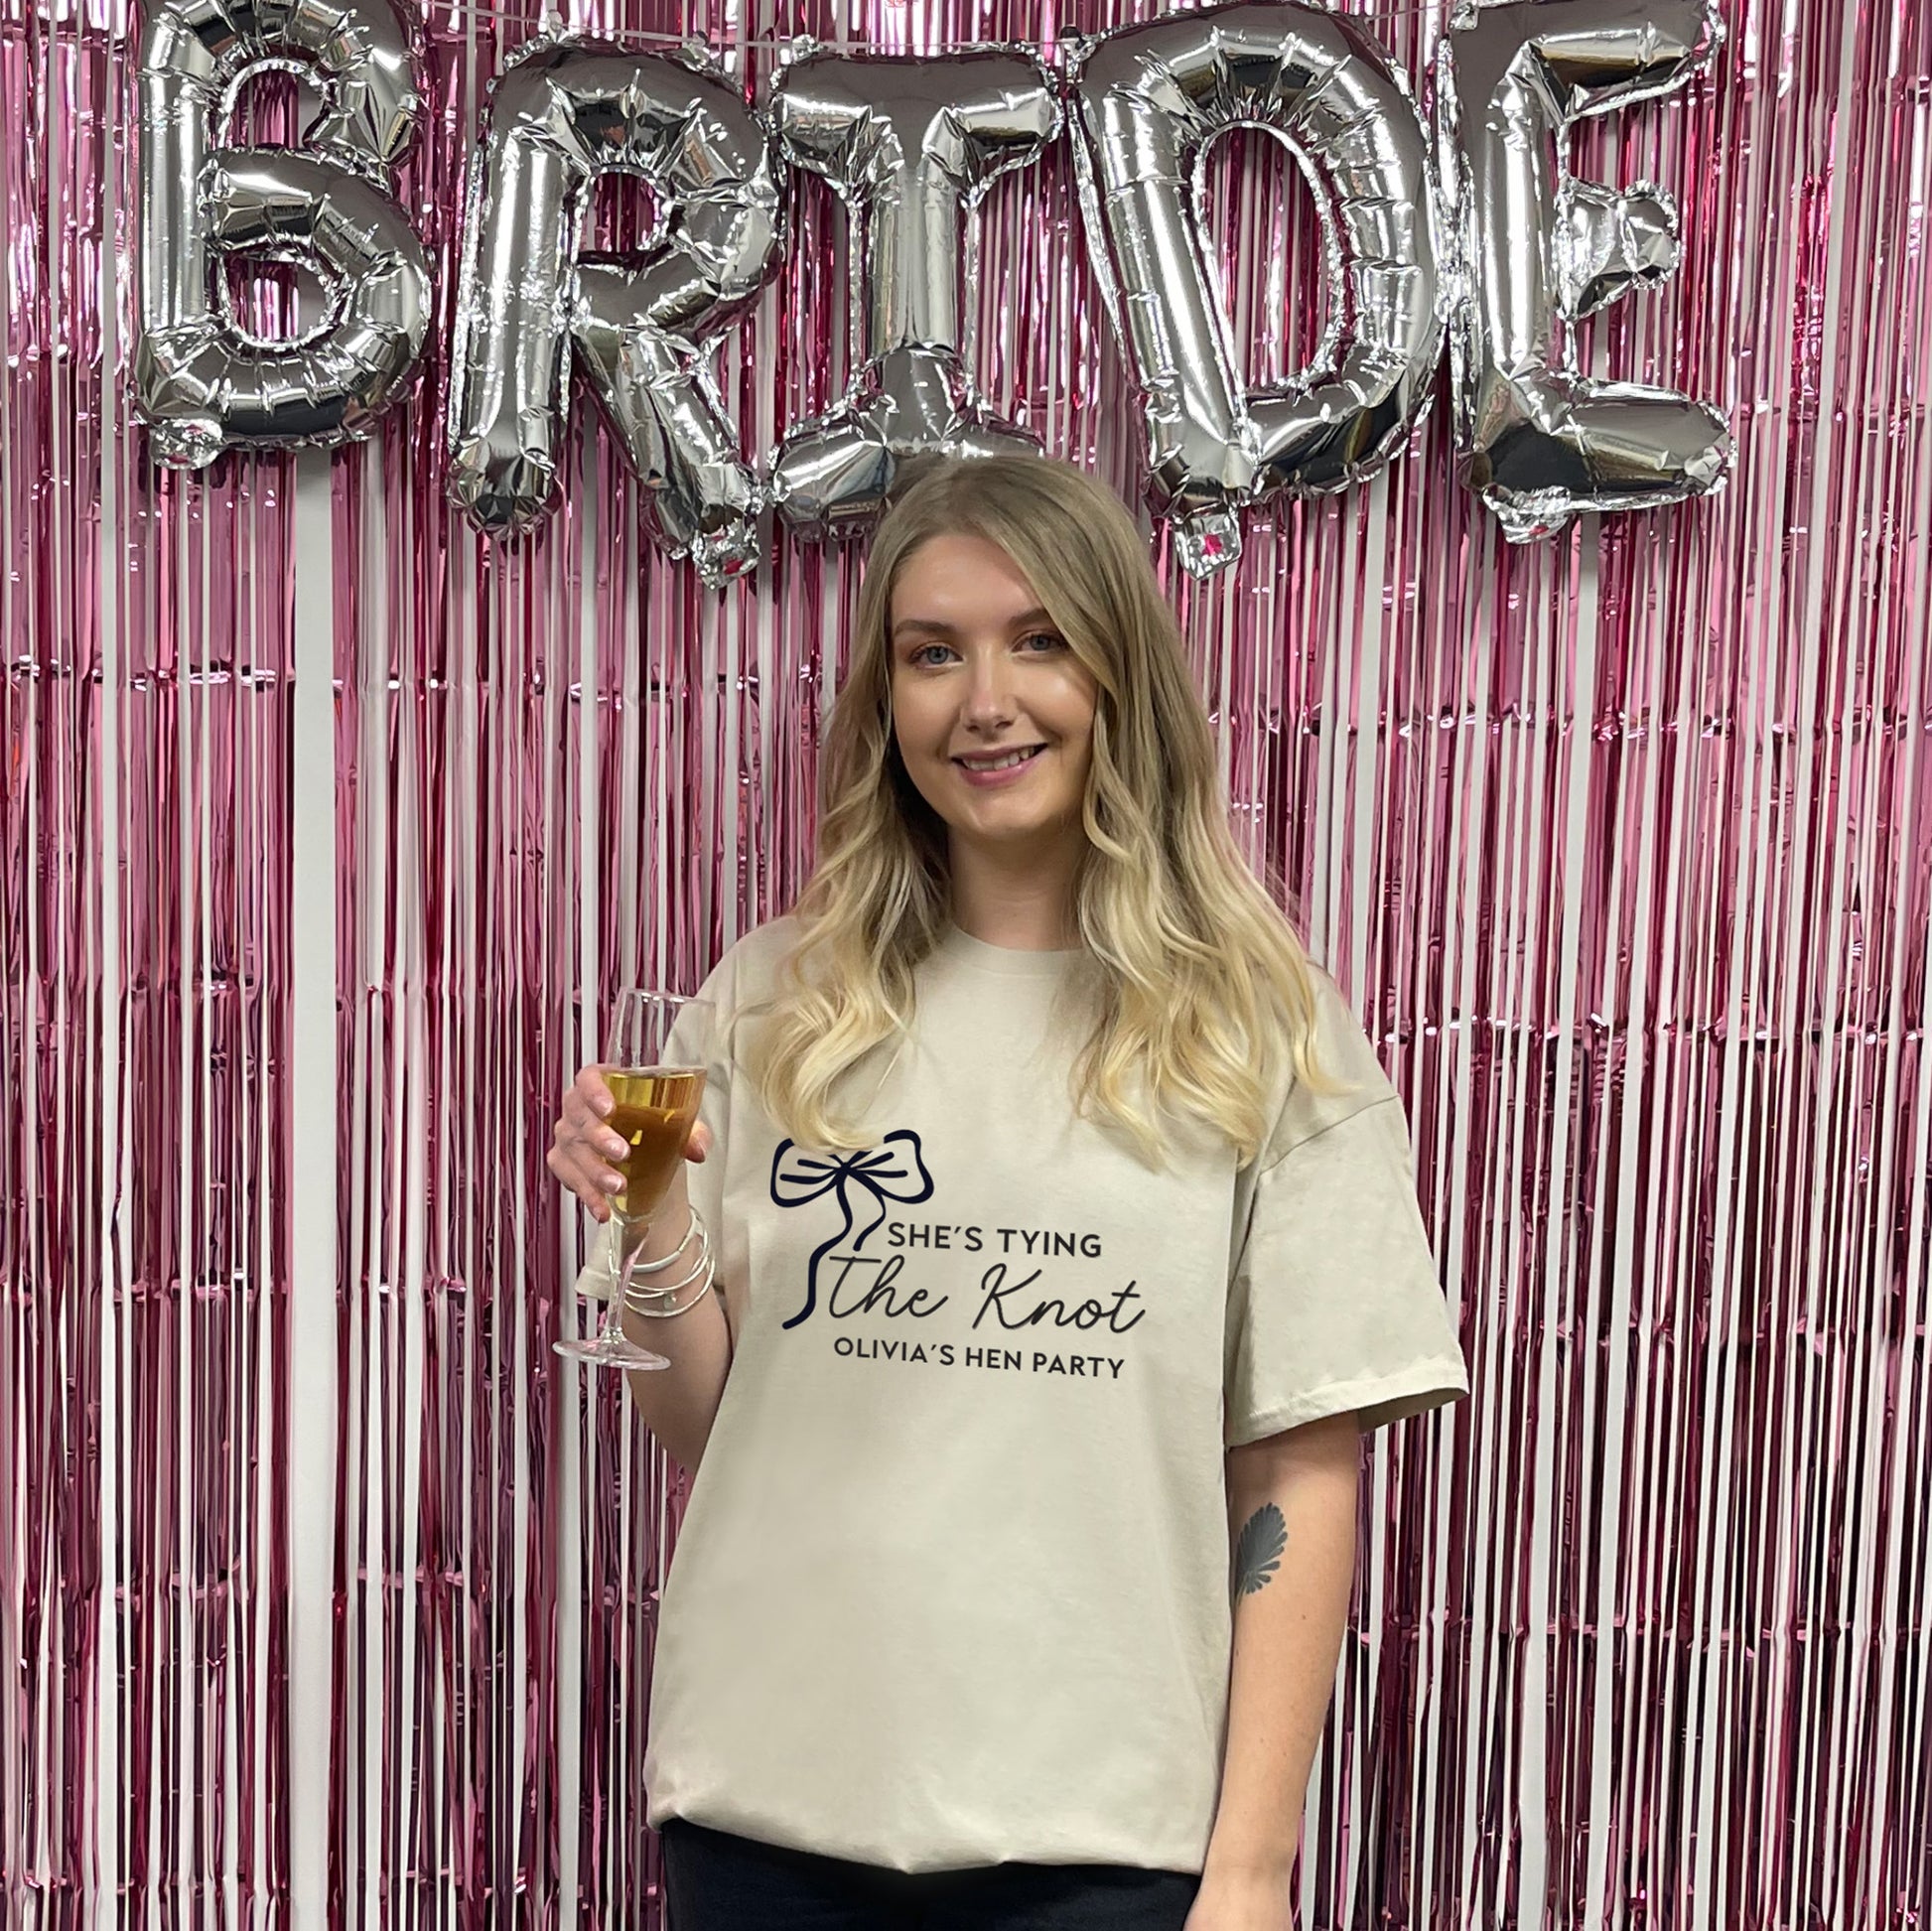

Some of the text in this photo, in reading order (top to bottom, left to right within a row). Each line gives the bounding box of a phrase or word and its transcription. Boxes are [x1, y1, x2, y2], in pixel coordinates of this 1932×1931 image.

[133, 0, 1740, 588] BRIDE
[887, 1220, 1103, 1259] SHE'S TYING
[970, 1262, 1147, 1334] Knot
[832, 1335, 1126, 1380] OLIVIA'S HEN PARTY
